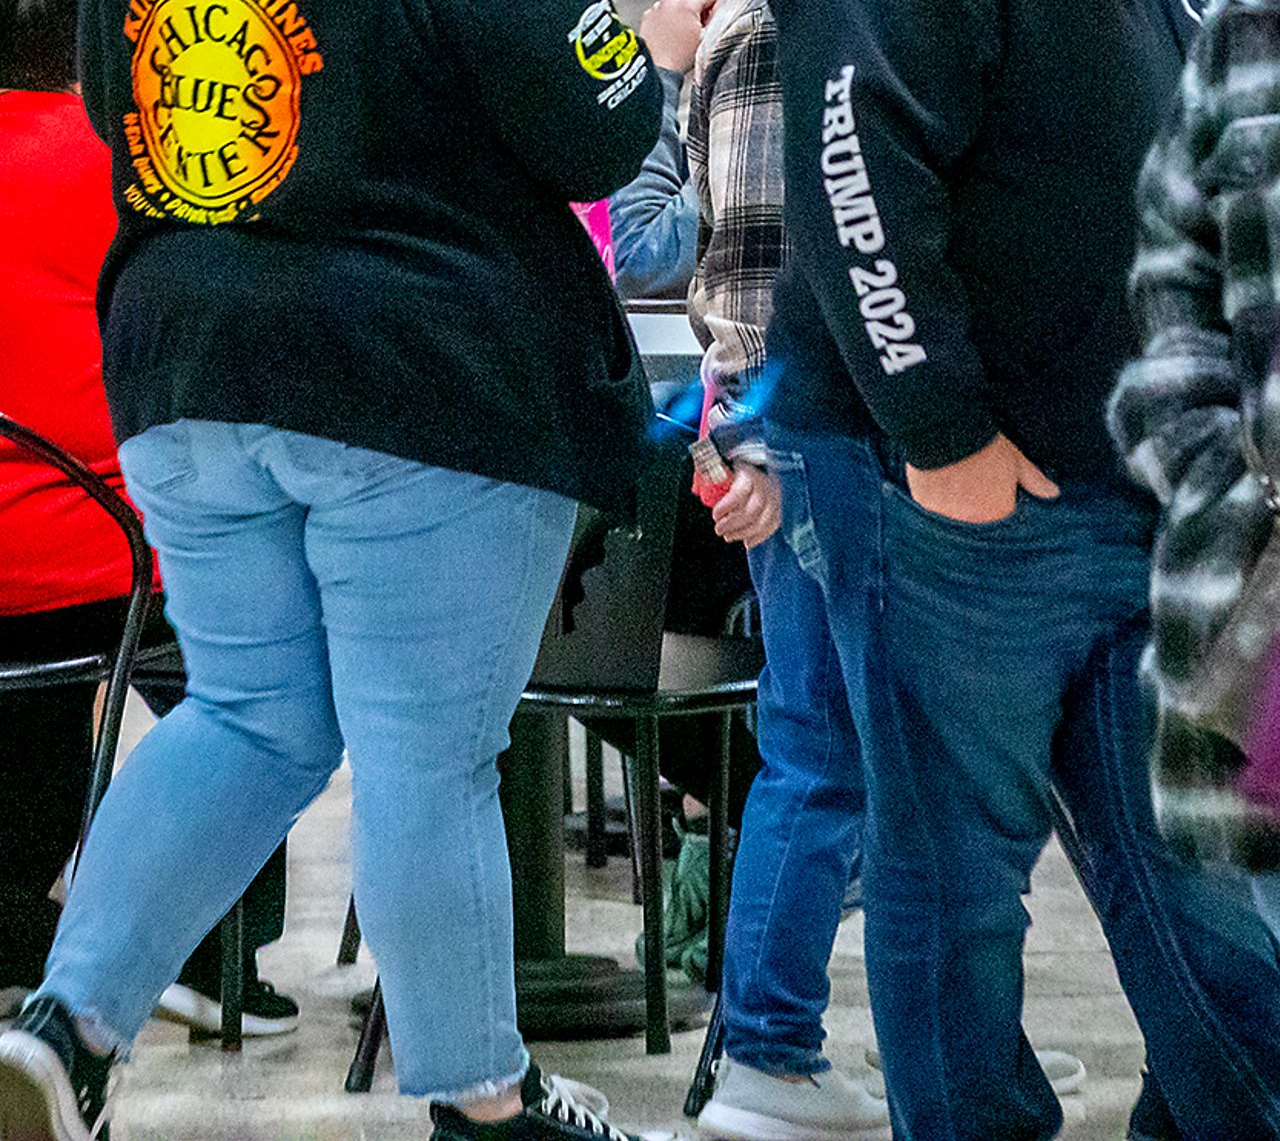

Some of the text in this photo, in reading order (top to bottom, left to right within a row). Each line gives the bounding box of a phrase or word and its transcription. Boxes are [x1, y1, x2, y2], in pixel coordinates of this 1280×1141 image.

[149, 4, 282, 102] CHICAGO
[158, 65, 277, 130] BLUES
[821, 65, 927, 376] TRUMP 2024
